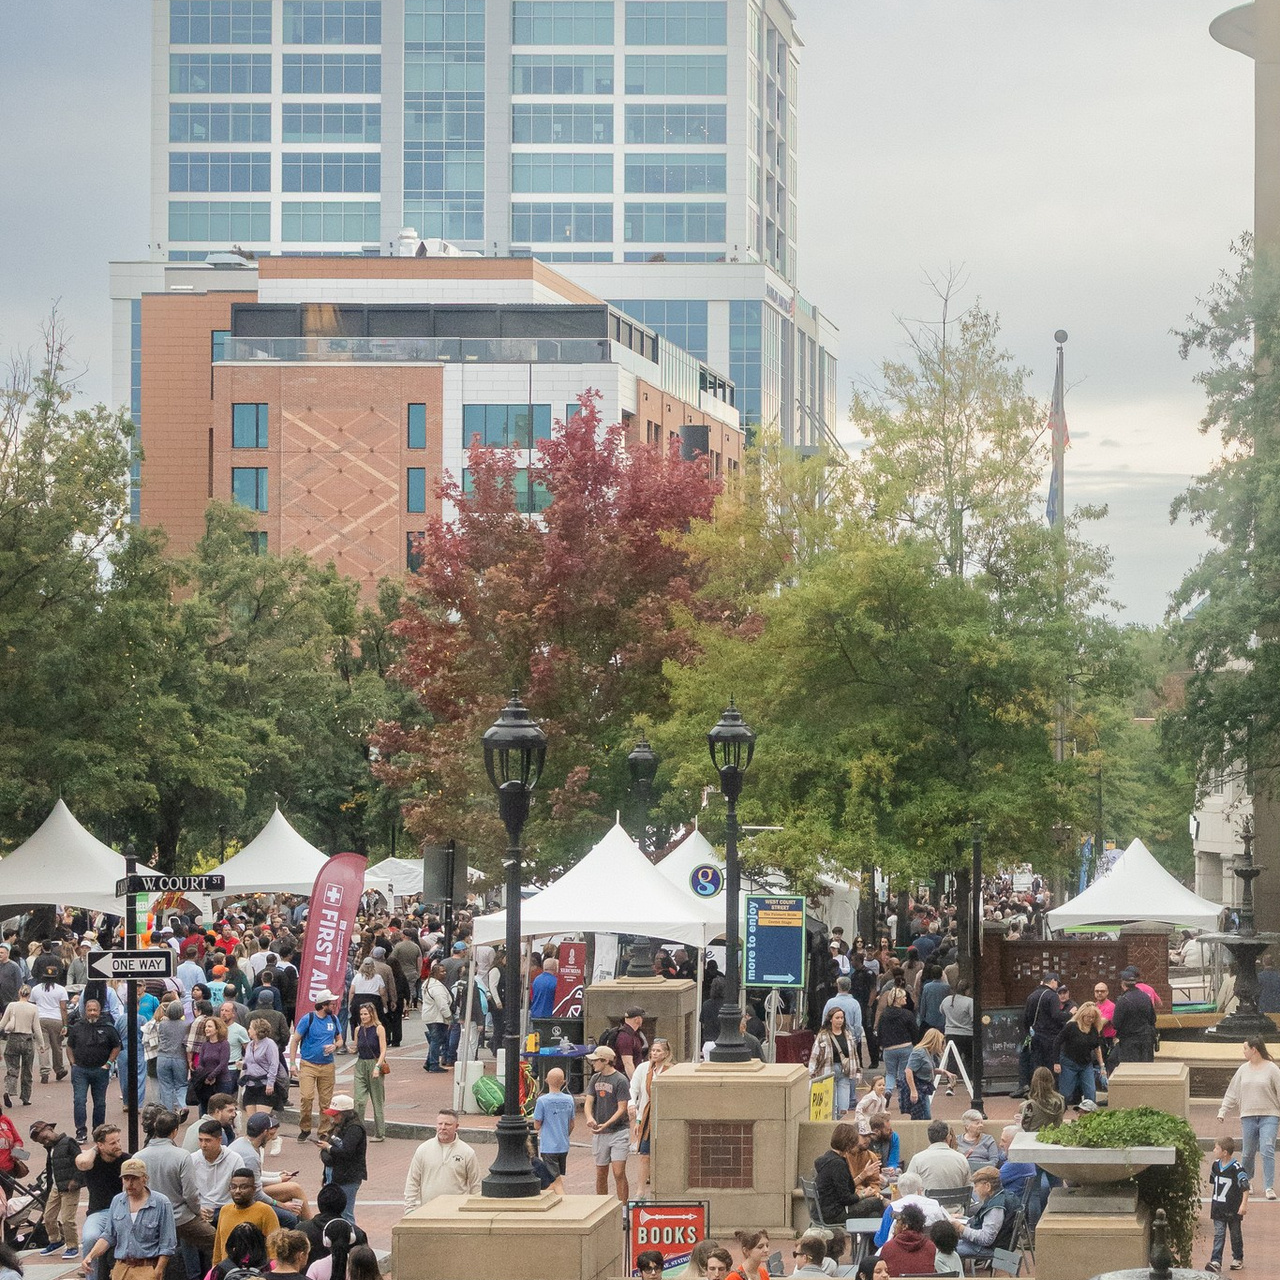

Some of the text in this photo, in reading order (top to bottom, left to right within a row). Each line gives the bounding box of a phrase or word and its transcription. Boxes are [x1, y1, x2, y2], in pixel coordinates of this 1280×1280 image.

[142, 877, 156, 890] W.
[159, 877, 209, 890] COURT
[212, 876, 222, 884] ST
[748, 901, 758, 933] enjoy
[314, 908, 339, 966] FIRST
[747, 937, 756, 949] to
[112, 959, 163, 970] ONE WAY
[1213, 1176, 1232, 1202] 17
[638, 1226, 697, 1244] BOOKS
